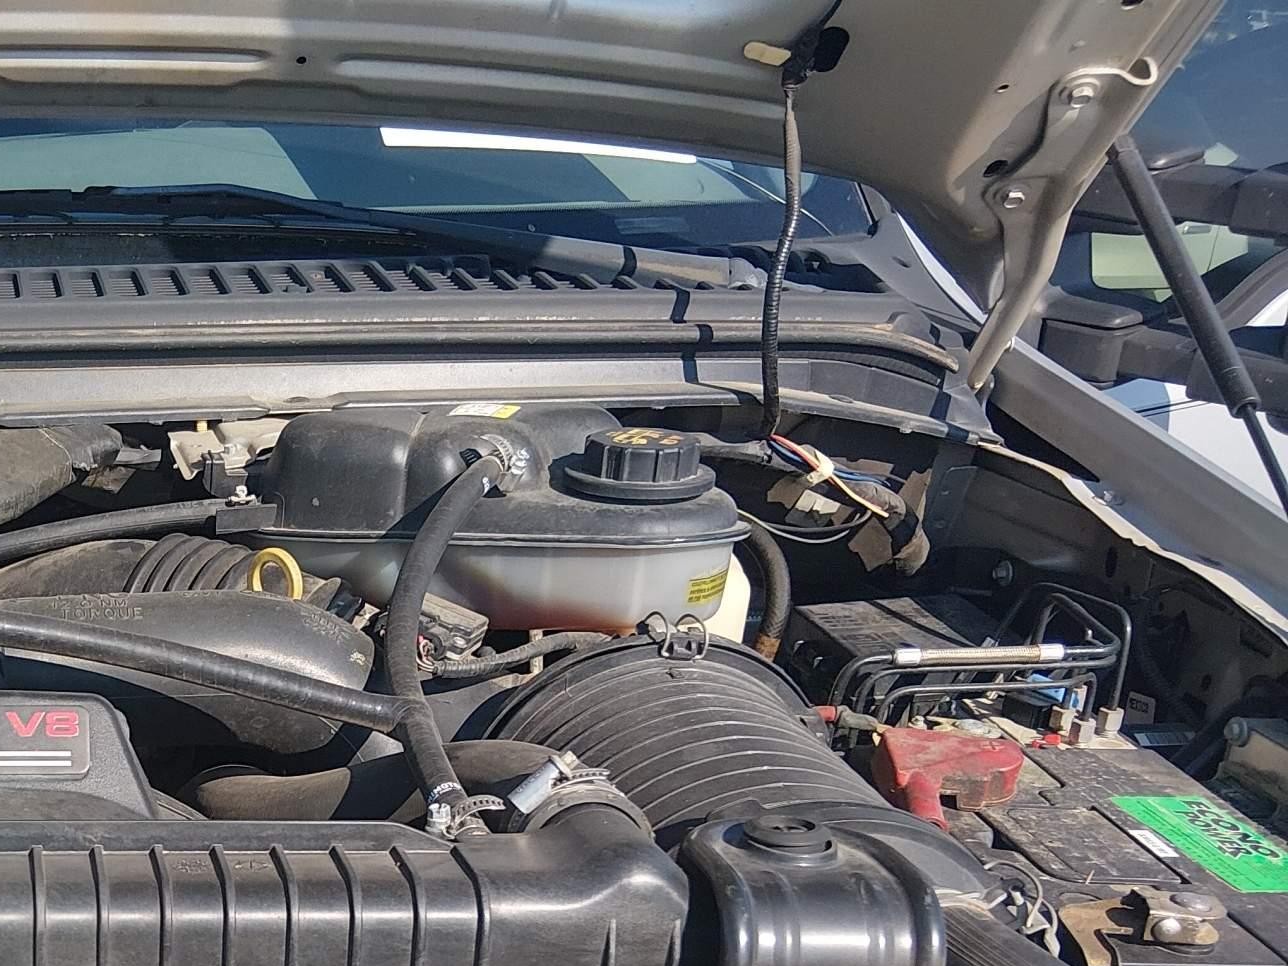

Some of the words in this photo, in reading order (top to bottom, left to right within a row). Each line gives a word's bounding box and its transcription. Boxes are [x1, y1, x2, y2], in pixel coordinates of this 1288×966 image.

[62, 607, 144, 620] TORQUE
[6, 710, 81, 738] V8
[1174, 810, 1253, 858] POWER
[1181, 800, 1281, 859] ECONO
